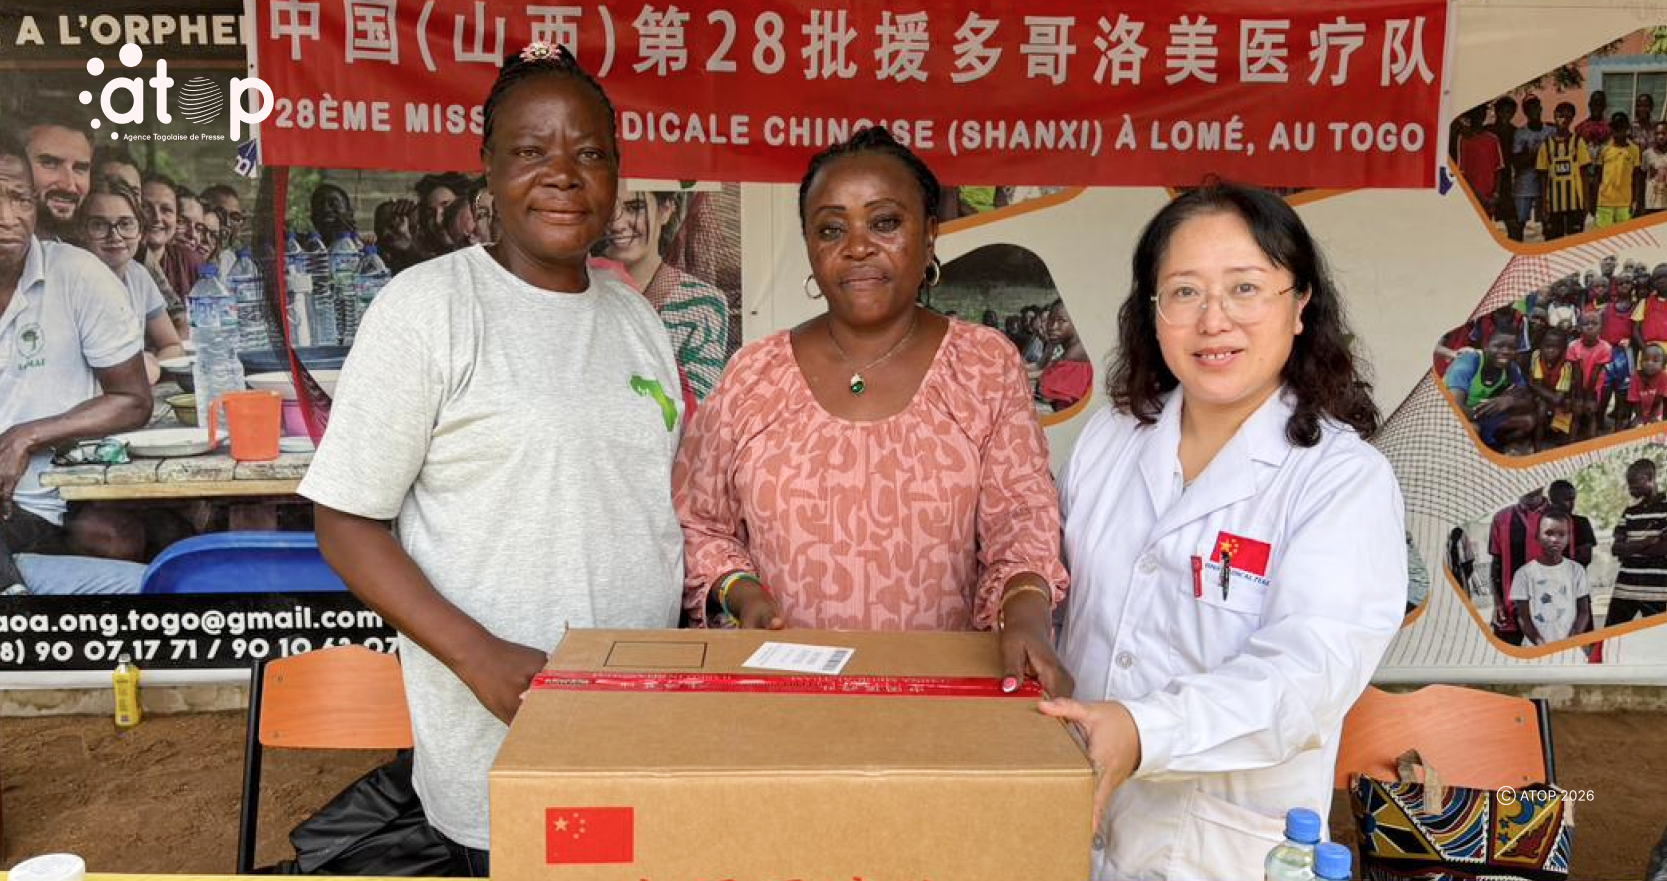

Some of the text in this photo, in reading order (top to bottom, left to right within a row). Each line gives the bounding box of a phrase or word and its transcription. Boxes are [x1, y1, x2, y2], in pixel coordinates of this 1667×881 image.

[15, 15, 45, 45] A
[275, 93, 391, 132] 28ÈME
[404, 102, 485, 135] MISS
[616, 110, 749, 146] DICALE
[947, 119, 1102, 157] (SHANXI)
[1115, 114, 1137, 150] À
[1150, 116, 1255, 156] LOMÉ,
[1268, 121, 1315, 151] AU
[1328, 121, 1425, 152] TOGO
[35, 640, 74, 662] 90
[84, 640, 124, 661] 07
[132, 639, 161, 660] 17
[170, 639, 198, 660] 71
[207, 638, 221, 660] /
[231, 637, 270, 658] 90
[278, 637, 312, 658] 10
